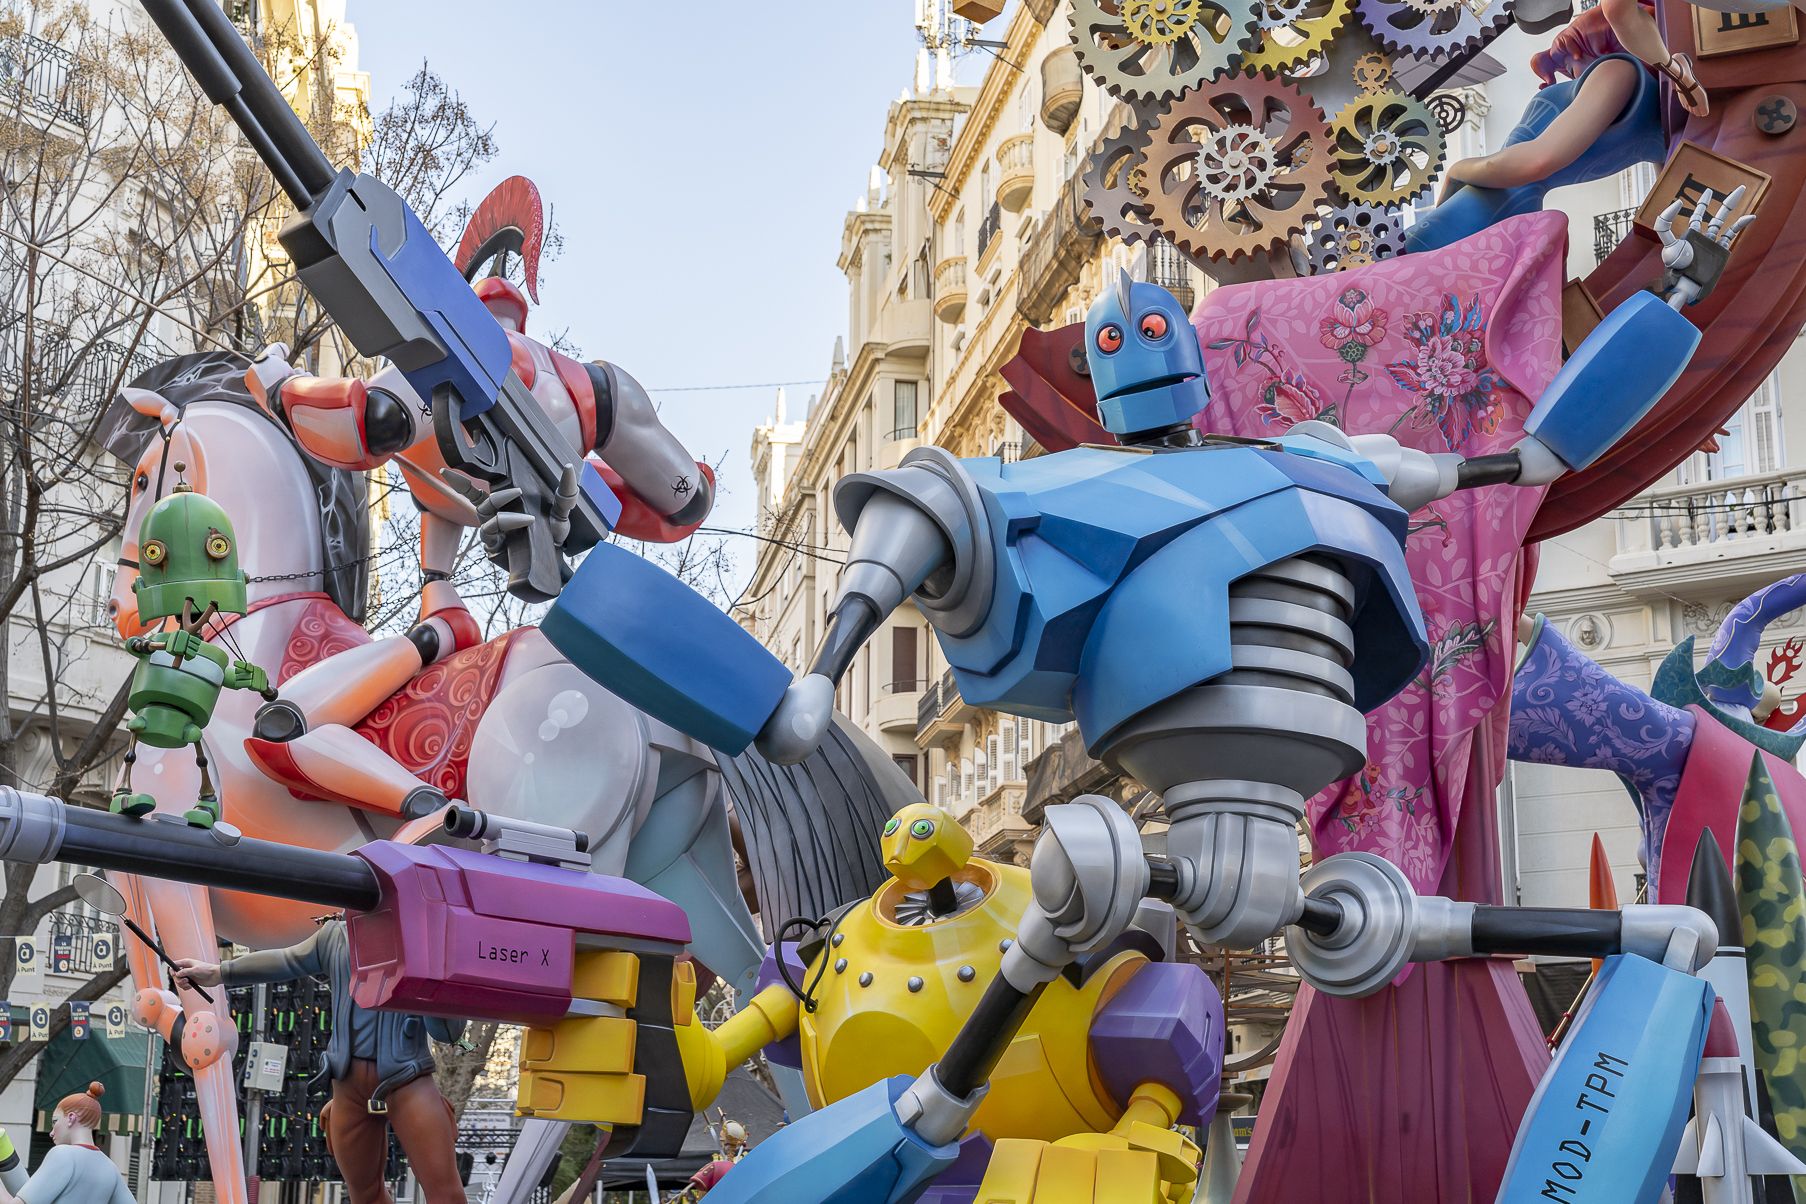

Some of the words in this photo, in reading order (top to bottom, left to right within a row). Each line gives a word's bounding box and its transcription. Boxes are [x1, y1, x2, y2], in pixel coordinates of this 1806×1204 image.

[478, 940, 529, 963] Laser
[541, 948, 550, 967] X
[1541, 1051, 1629, 1204] MOD-TPM
